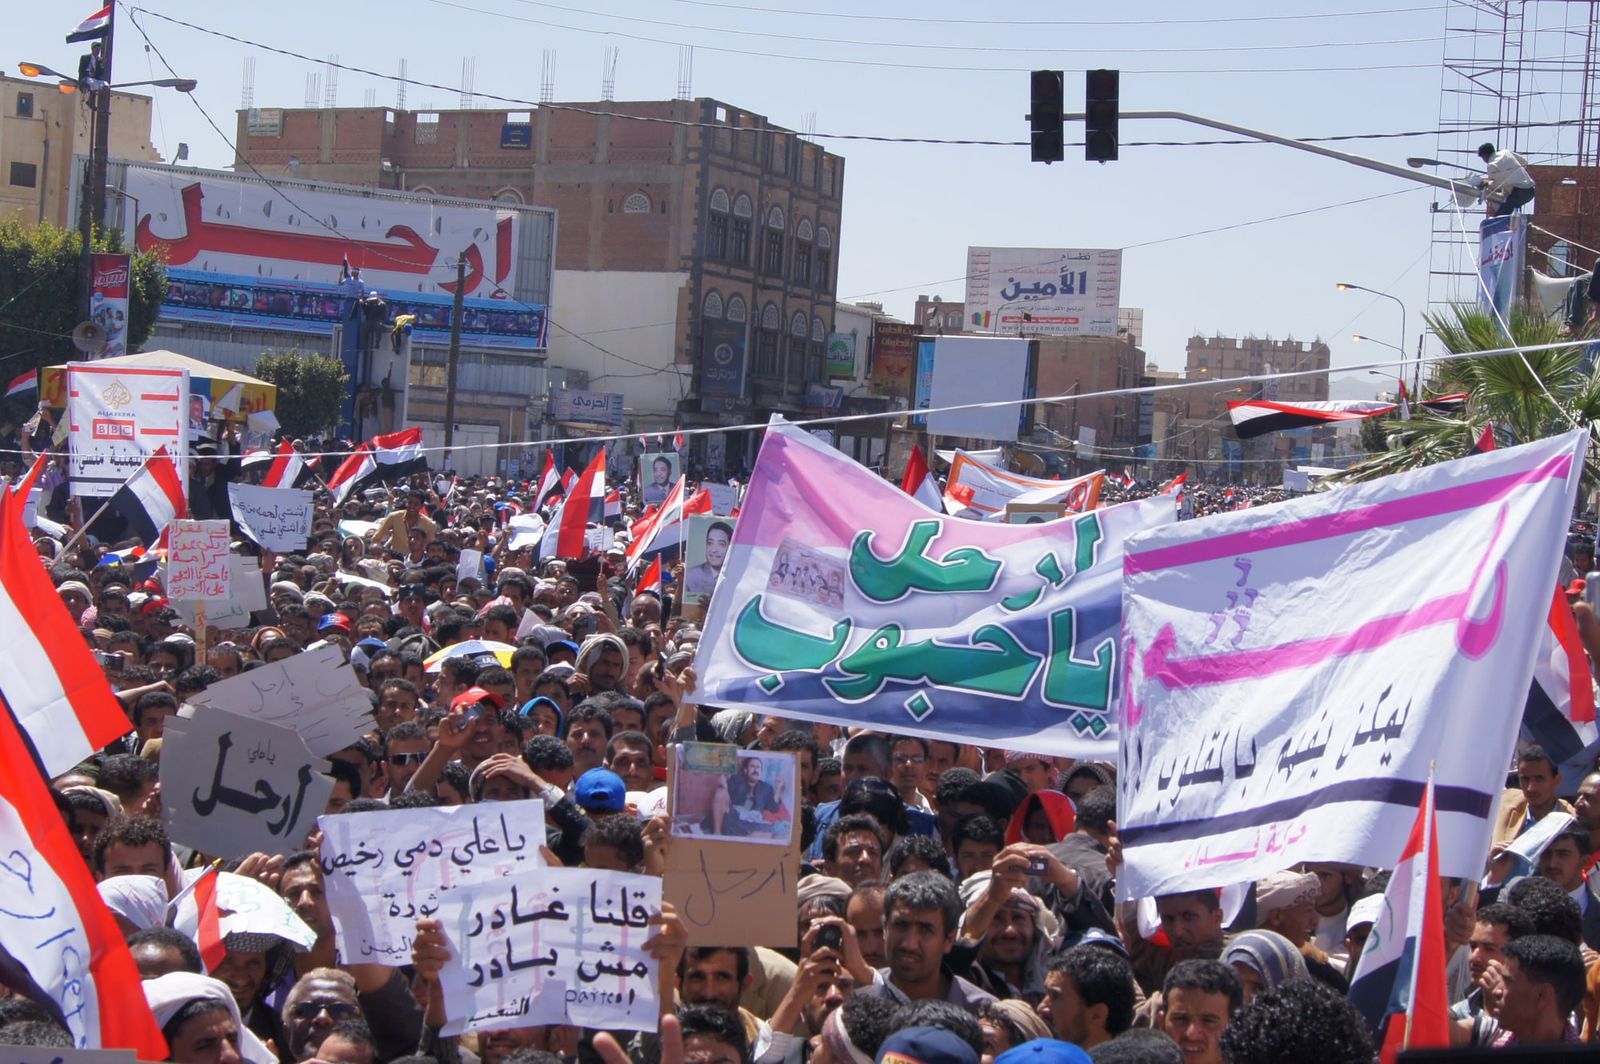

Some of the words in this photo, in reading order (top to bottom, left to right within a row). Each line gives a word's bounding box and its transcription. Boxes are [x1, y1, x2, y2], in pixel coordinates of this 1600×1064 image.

[1000, 265, 1088, 302] الأمين
[96, 424, 132, 435] BBC
[192, 731, 312, 838] ارحل
[322, 841, 385, 876] رخيص
[394, 839, 443, 876] دمي
[467, 885, 569, 937] غادر
[590, 880, 650, 928] قلنا
[467, 937, 558, 987] بادر
[577, 941, 649, 982] مش
